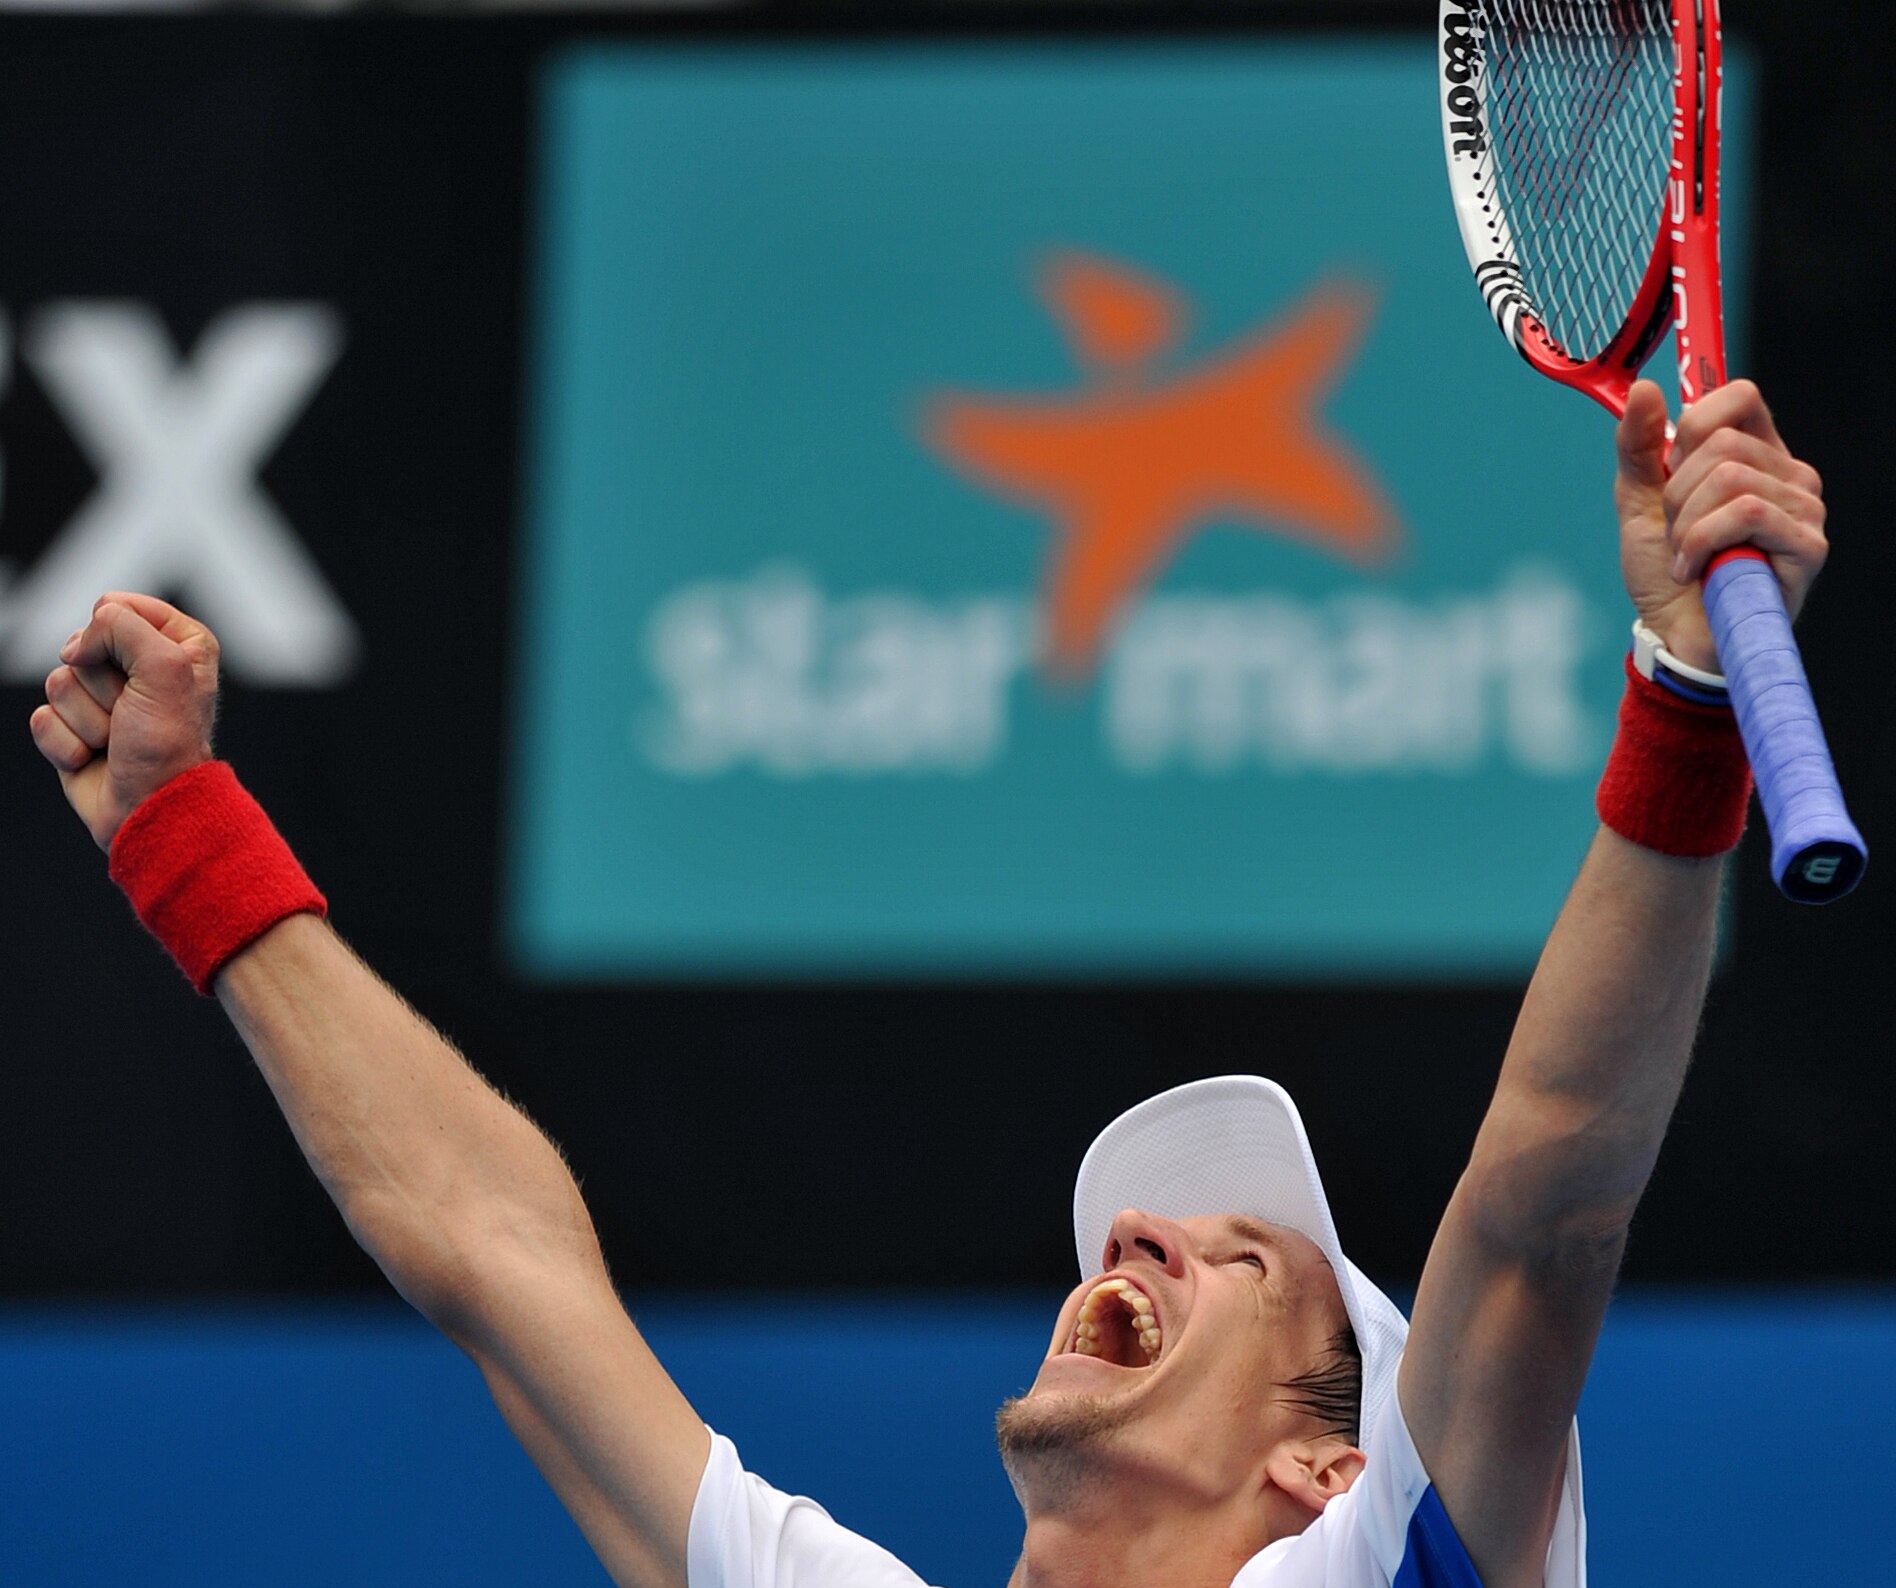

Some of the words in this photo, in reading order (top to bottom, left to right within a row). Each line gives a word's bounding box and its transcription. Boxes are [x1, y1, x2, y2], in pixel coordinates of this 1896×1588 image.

[0, 298, 364, 688] X
[648, 568, 1035, 773] star
[1105, 565, 1590, 773] mart
